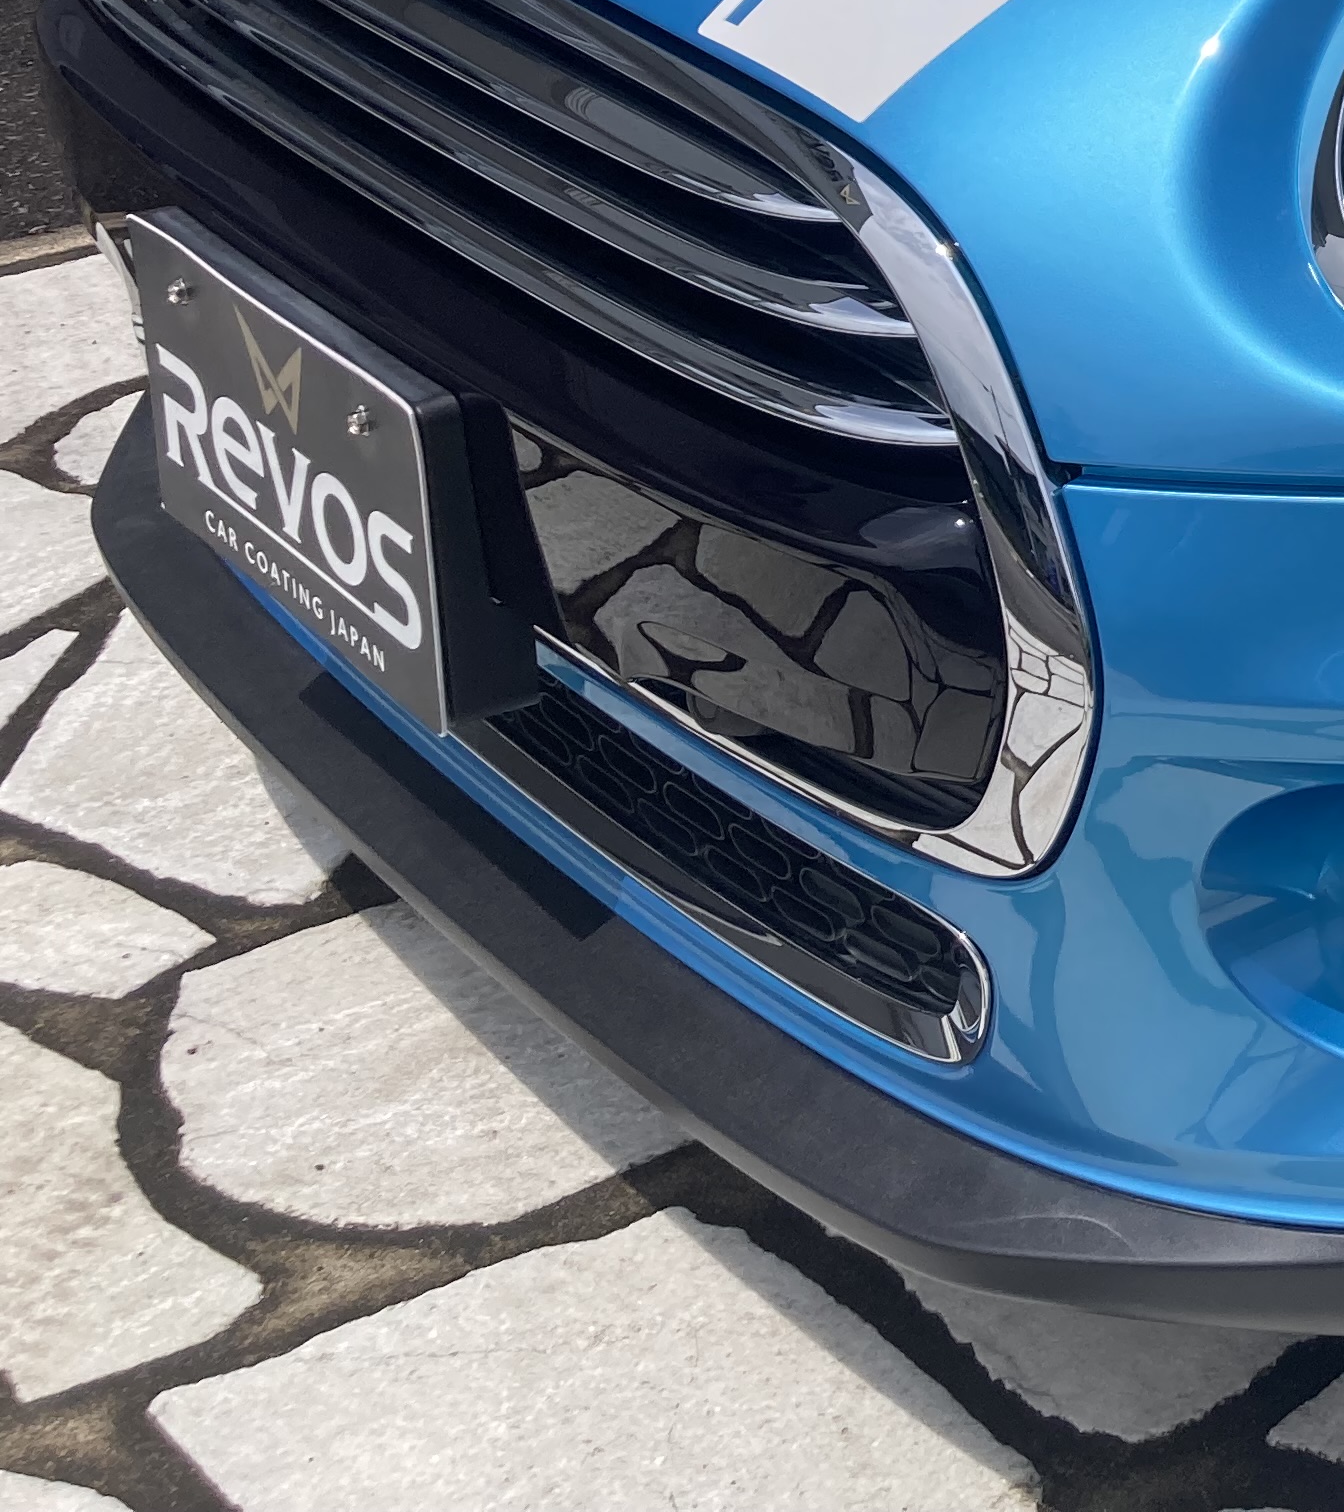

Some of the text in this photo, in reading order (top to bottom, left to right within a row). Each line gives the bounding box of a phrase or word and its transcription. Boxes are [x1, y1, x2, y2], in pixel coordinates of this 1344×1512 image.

[205, 509, 385, 673] CAR COATING JAPAN
